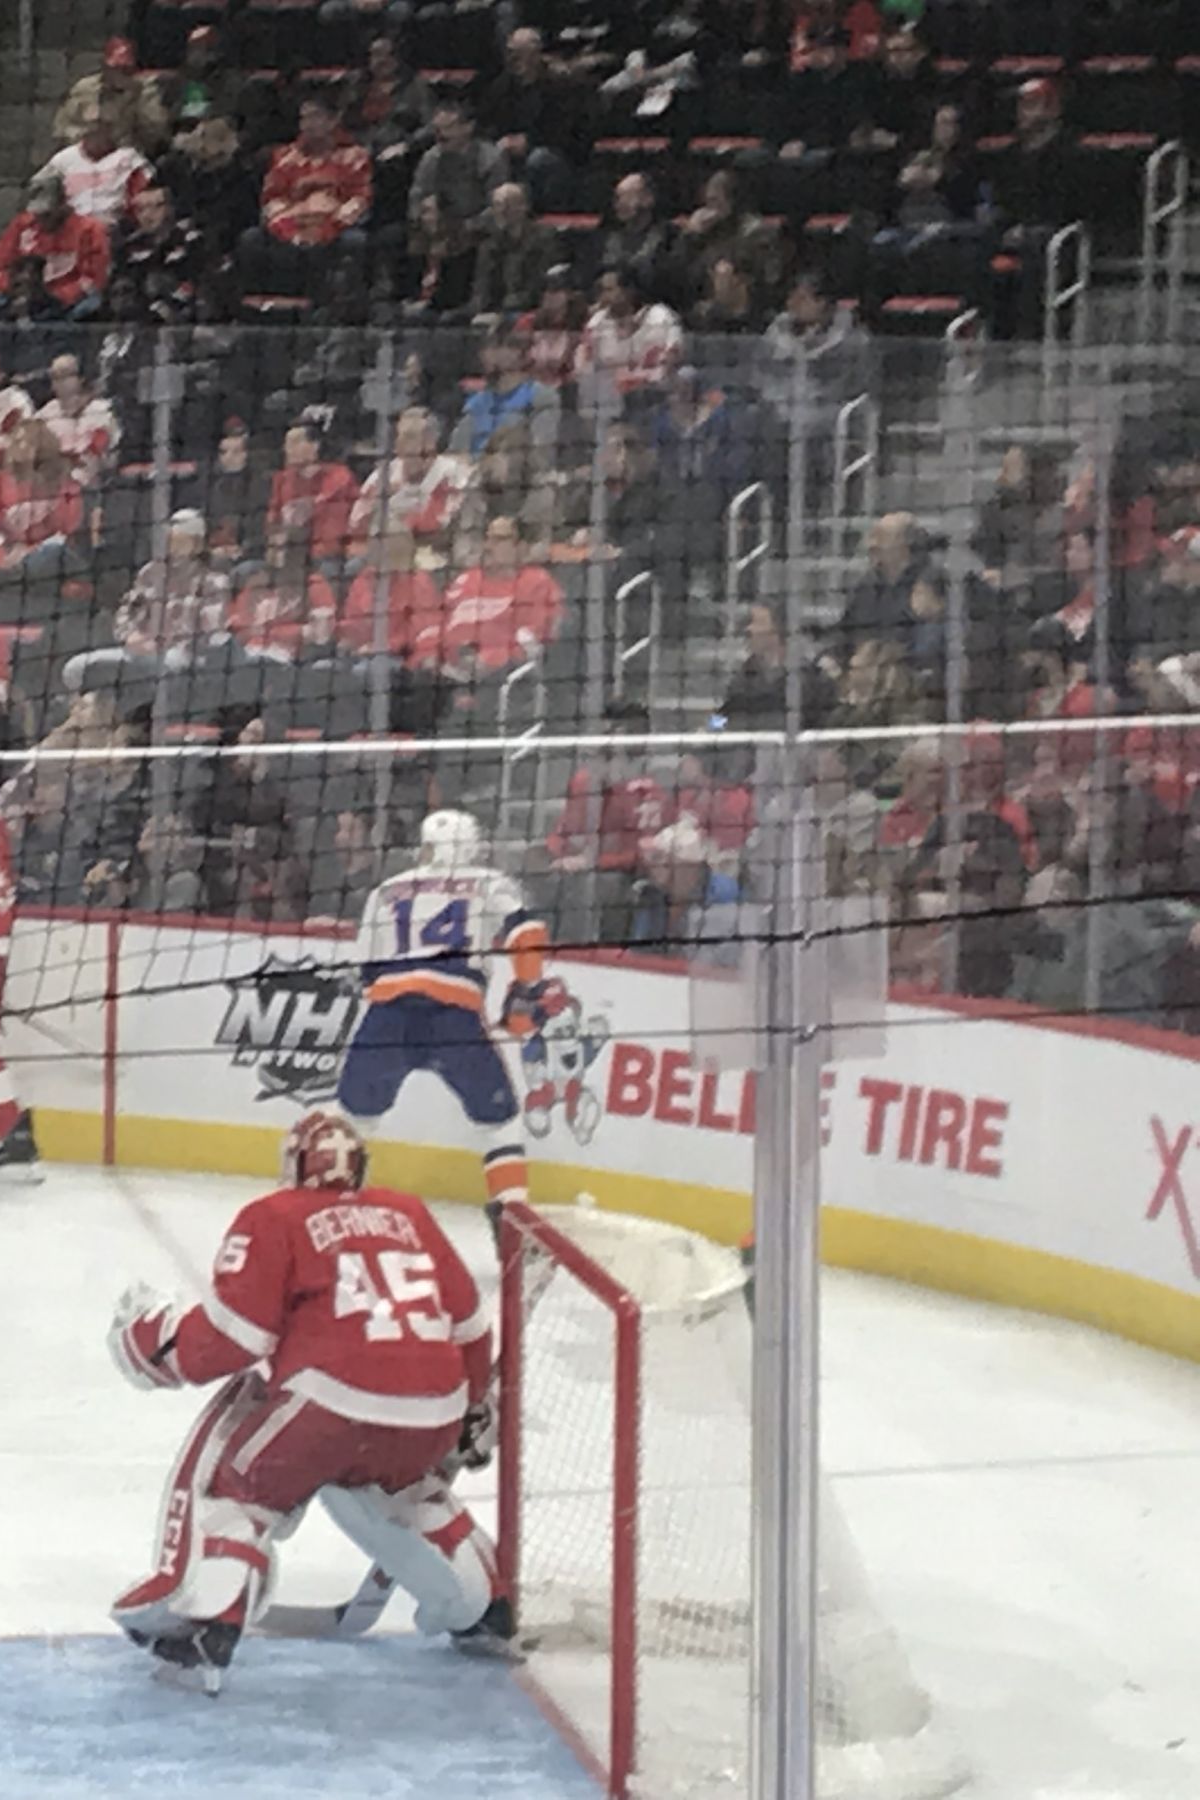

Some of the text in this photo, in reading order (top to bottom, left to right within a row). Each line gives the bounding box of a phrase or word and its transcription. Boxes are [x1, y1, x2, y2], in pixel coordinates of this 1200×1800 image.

[391, 898, 473, 957] 14
[216, 984, 360, 1047] NH
[858, 1077, 1010, 1179] TIRE
[334, 1251, 453, 1342] 45
